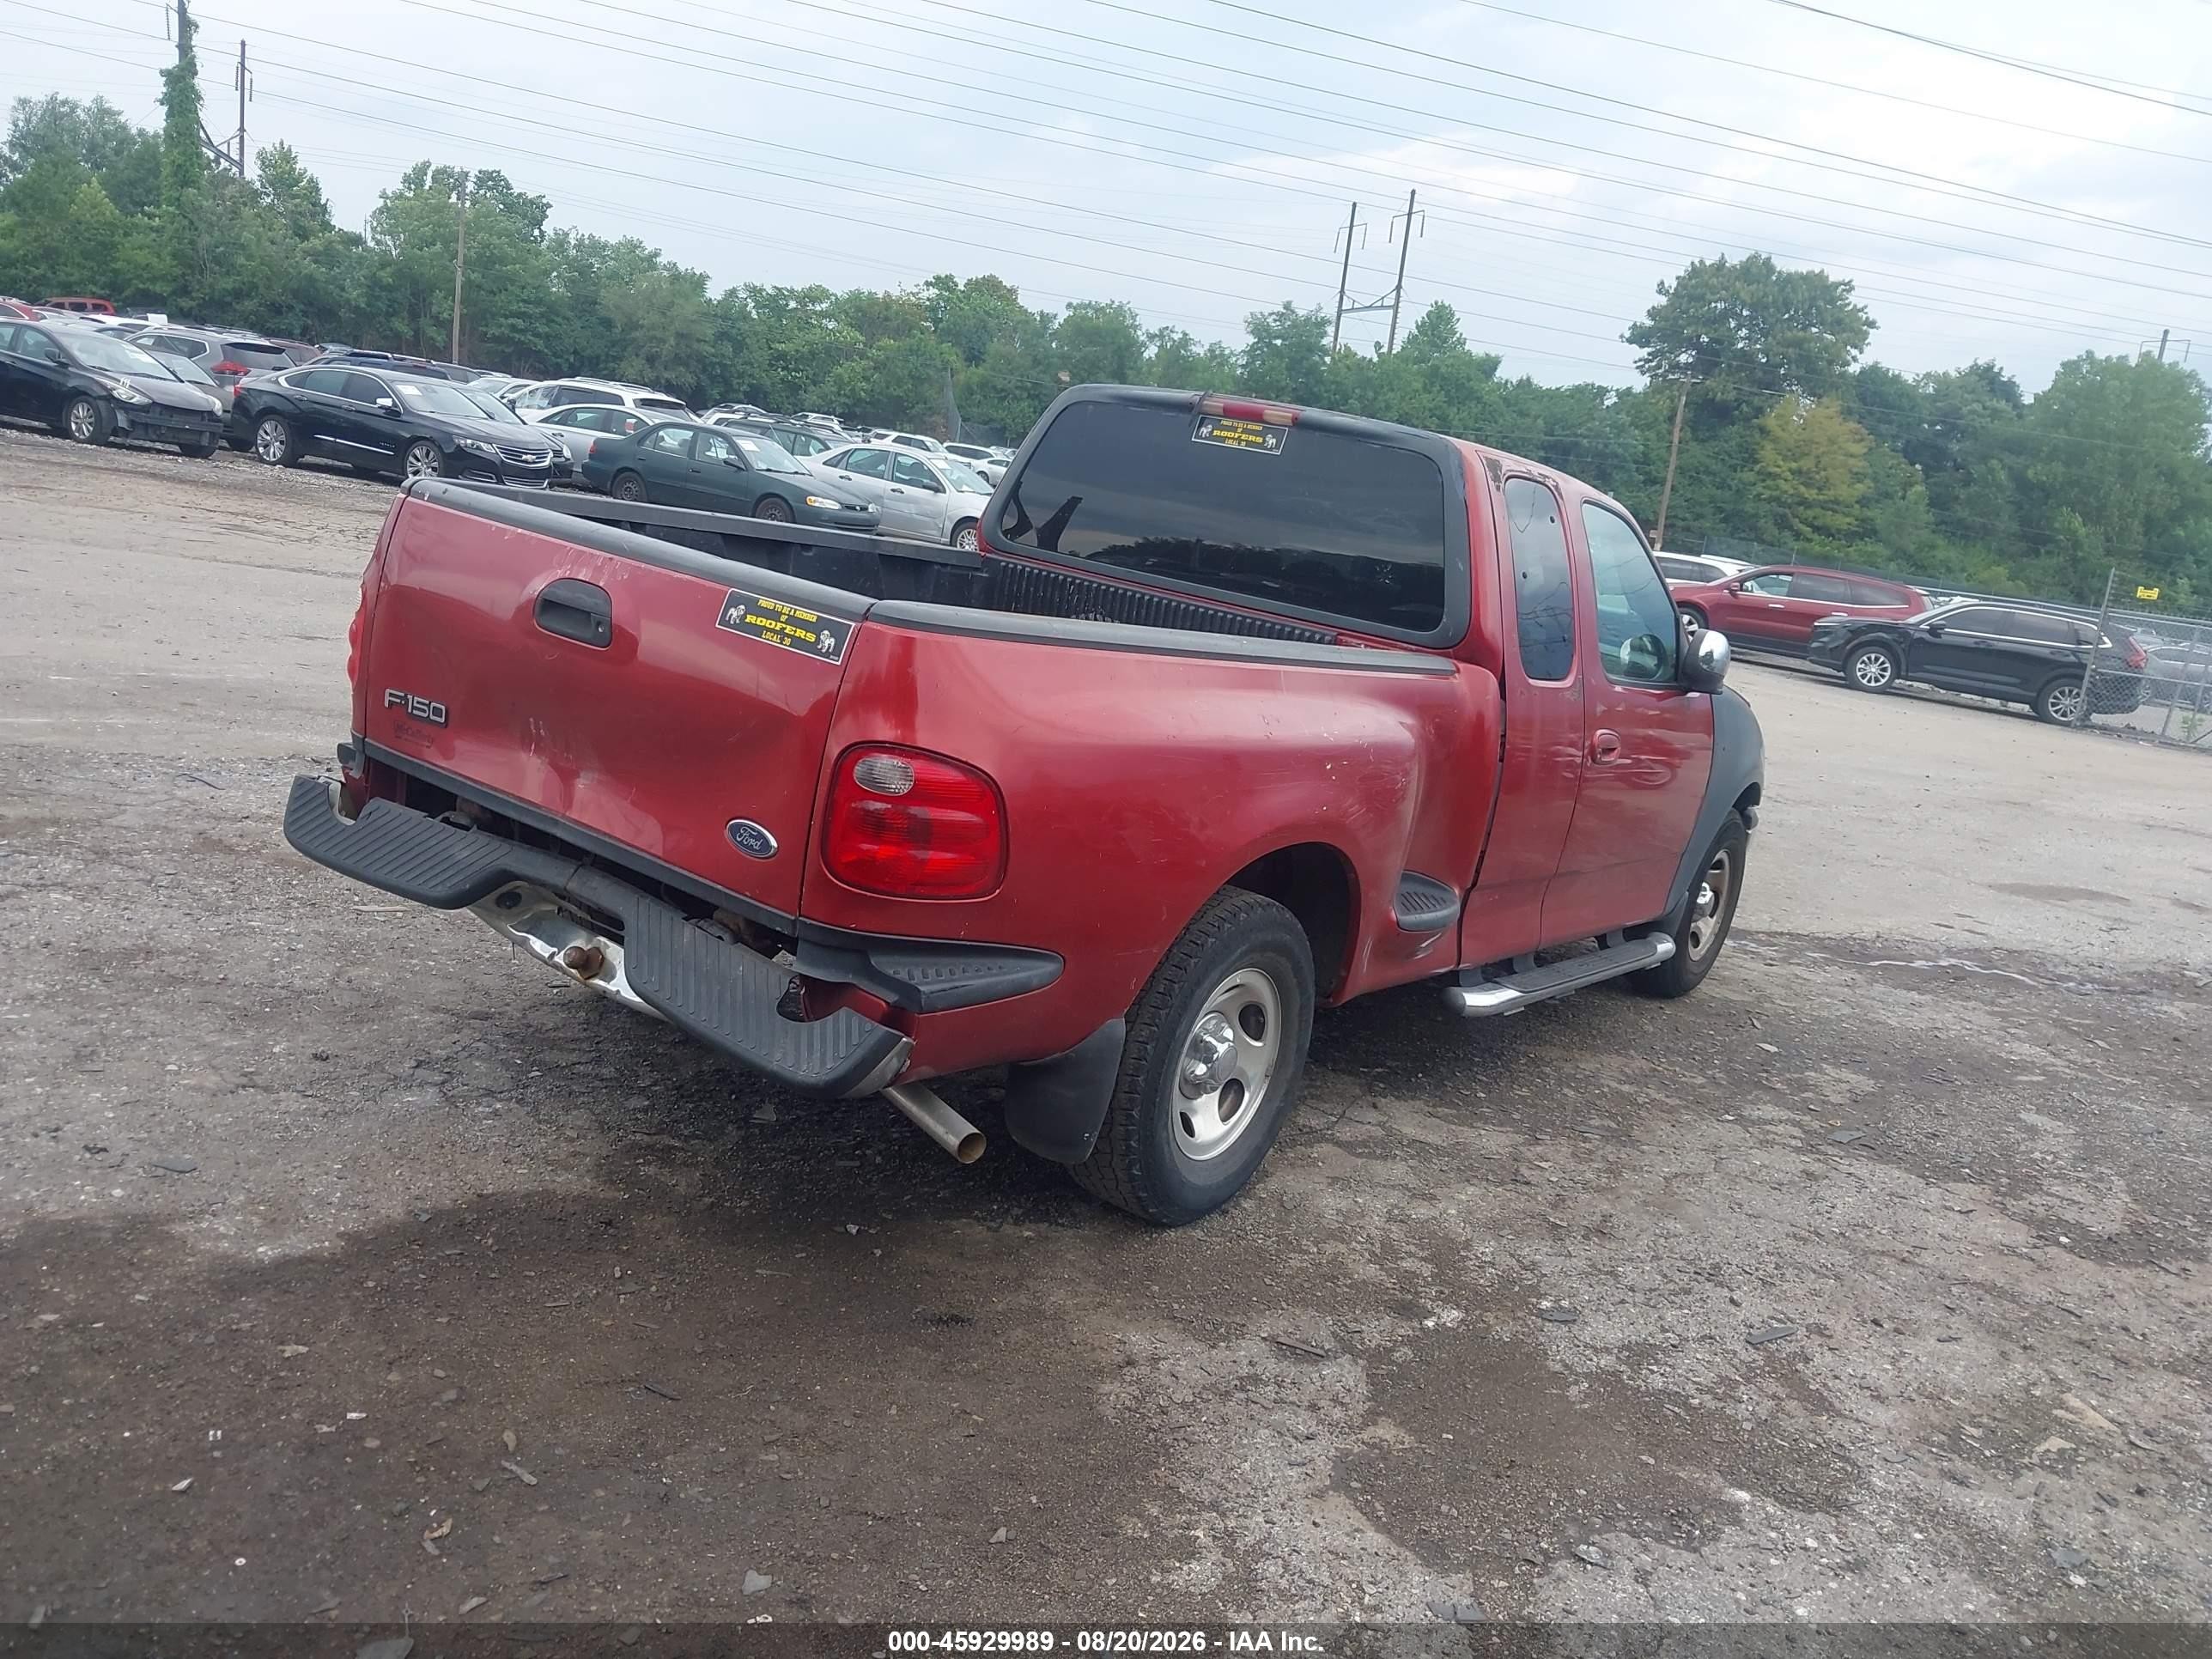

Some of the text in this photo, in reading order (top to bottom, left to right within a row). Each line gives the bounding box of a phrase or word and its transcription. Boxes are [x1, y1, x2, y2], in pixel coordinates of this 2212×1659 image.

[1212, 429, 1263, 443] ROOFERS
[757, 599, 775, 610] PROUD
[775, 604, 783, 612] TO
[781, 606, 791, 615] BE
[744, 613, 817, 642] ROOFERS
[761, 630, 792, 646] LOCAL 30
